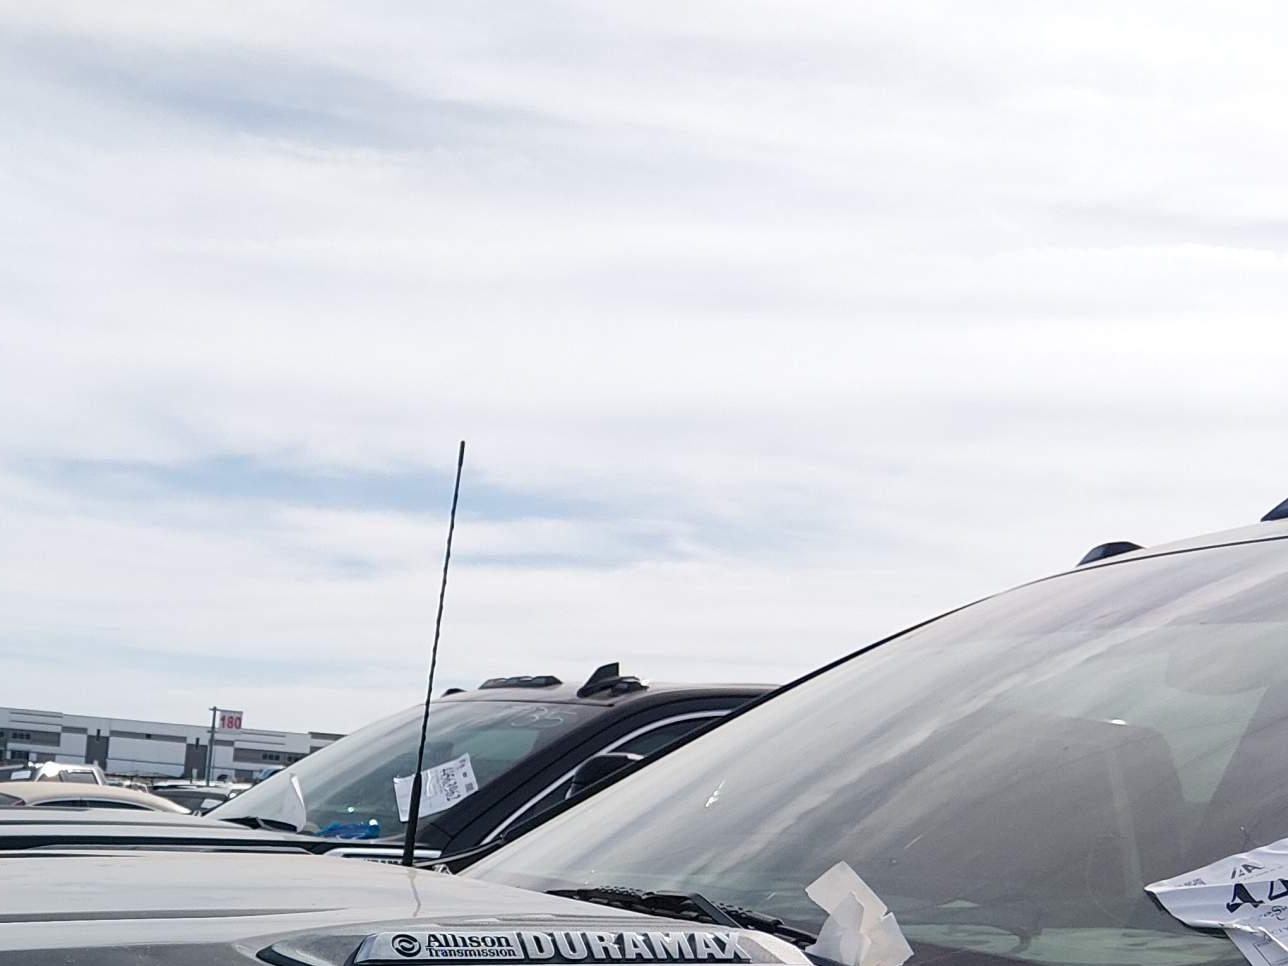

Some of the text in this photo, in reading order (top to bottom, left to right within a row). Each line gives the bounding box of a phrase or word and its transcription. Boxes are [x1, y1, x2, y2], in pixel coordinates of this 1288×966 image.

[220, 715, 242, 730] 180
[425, 933, 513, 948] Allison
[513, 931, 752, 963] DURAMAX
[425, 948, 517, 958] Transmission
